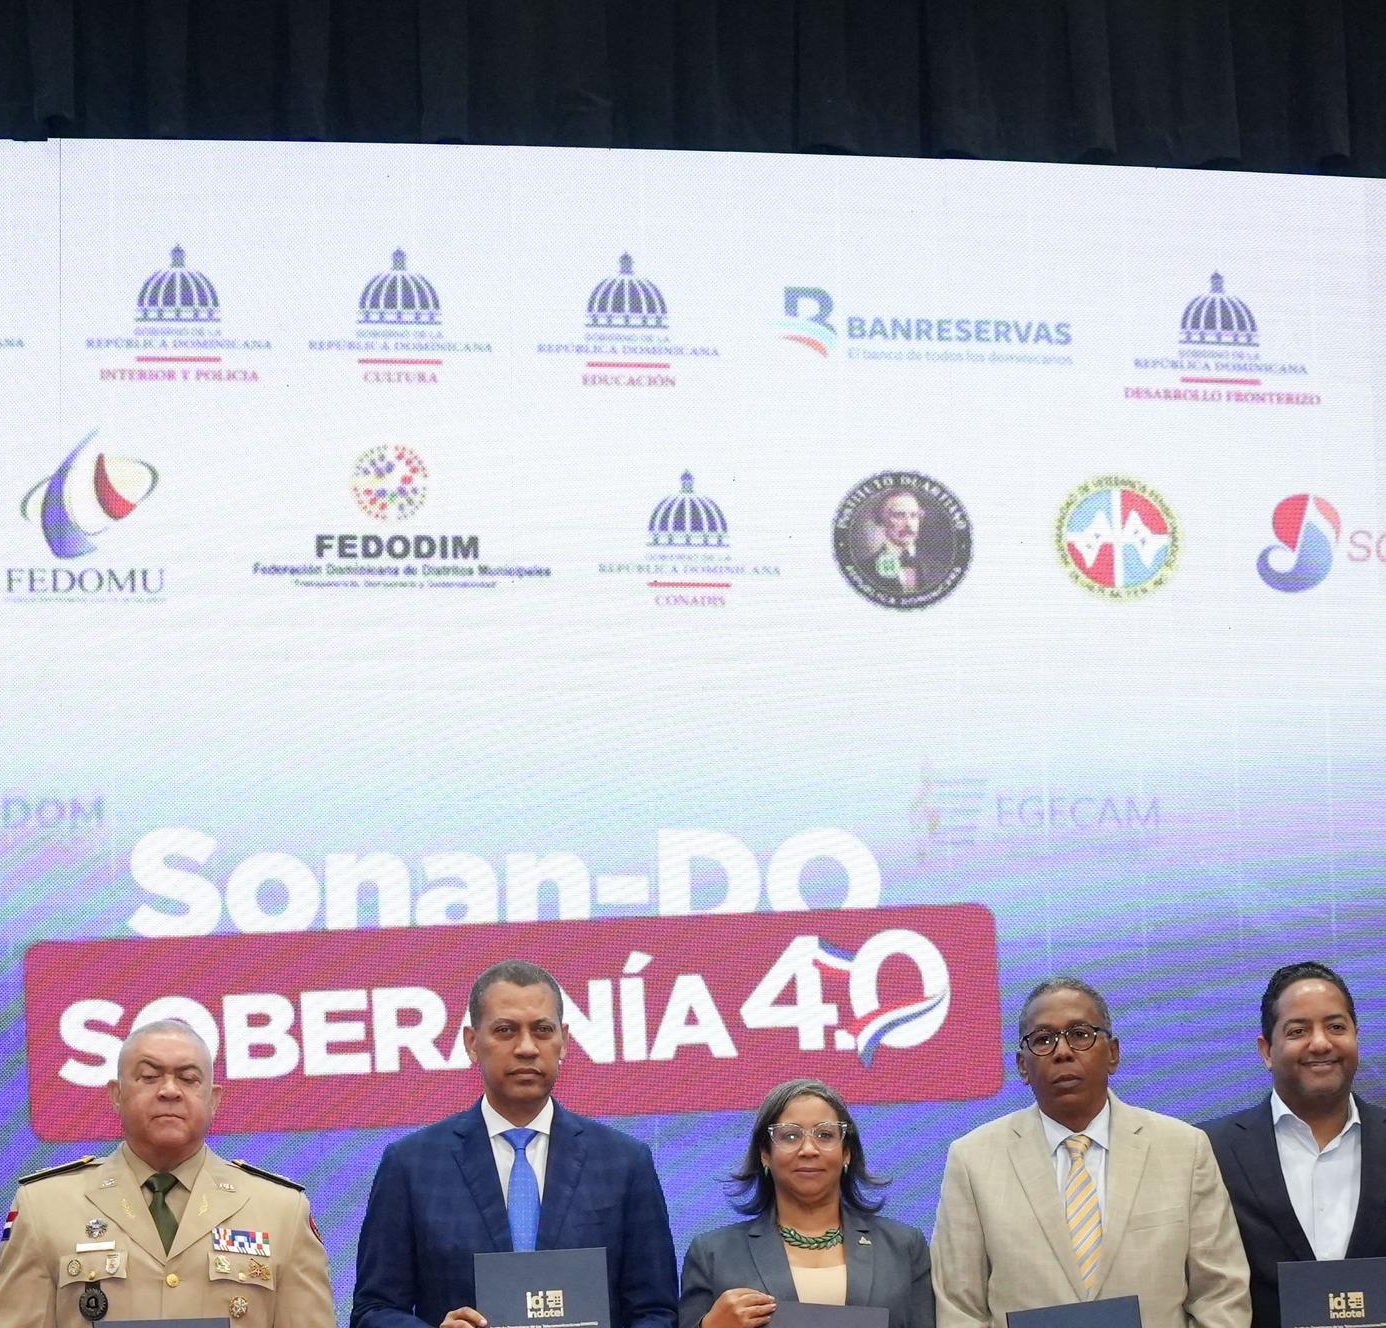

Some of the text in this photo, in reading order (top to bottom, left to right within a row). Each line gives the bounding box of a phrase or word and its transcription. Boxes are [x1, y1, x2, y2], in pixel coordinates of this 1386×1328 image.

[846, 316, 1073, 346] BANRESERVAS
[100, 369, 176, 381] INTERIOR
[181, 369, 190, 381] Y
[363, 371, 438, 384] CULTURA
[1124, 387, 1322, 406] DESARROLLO FRONTERIZO
[315, 535, 480, 560] FEDODIM
[403, 564, 417, 577] de
[6, 568, 165, 594] FEDOMU
[129, 826, 882, 938] Sonan-DO
[58, 928, 951, 1088] SOBERNÍA 4.0
[527, 1307, 565, 1319] indotel
[1329, 1308, 1366, 1320] indotel
